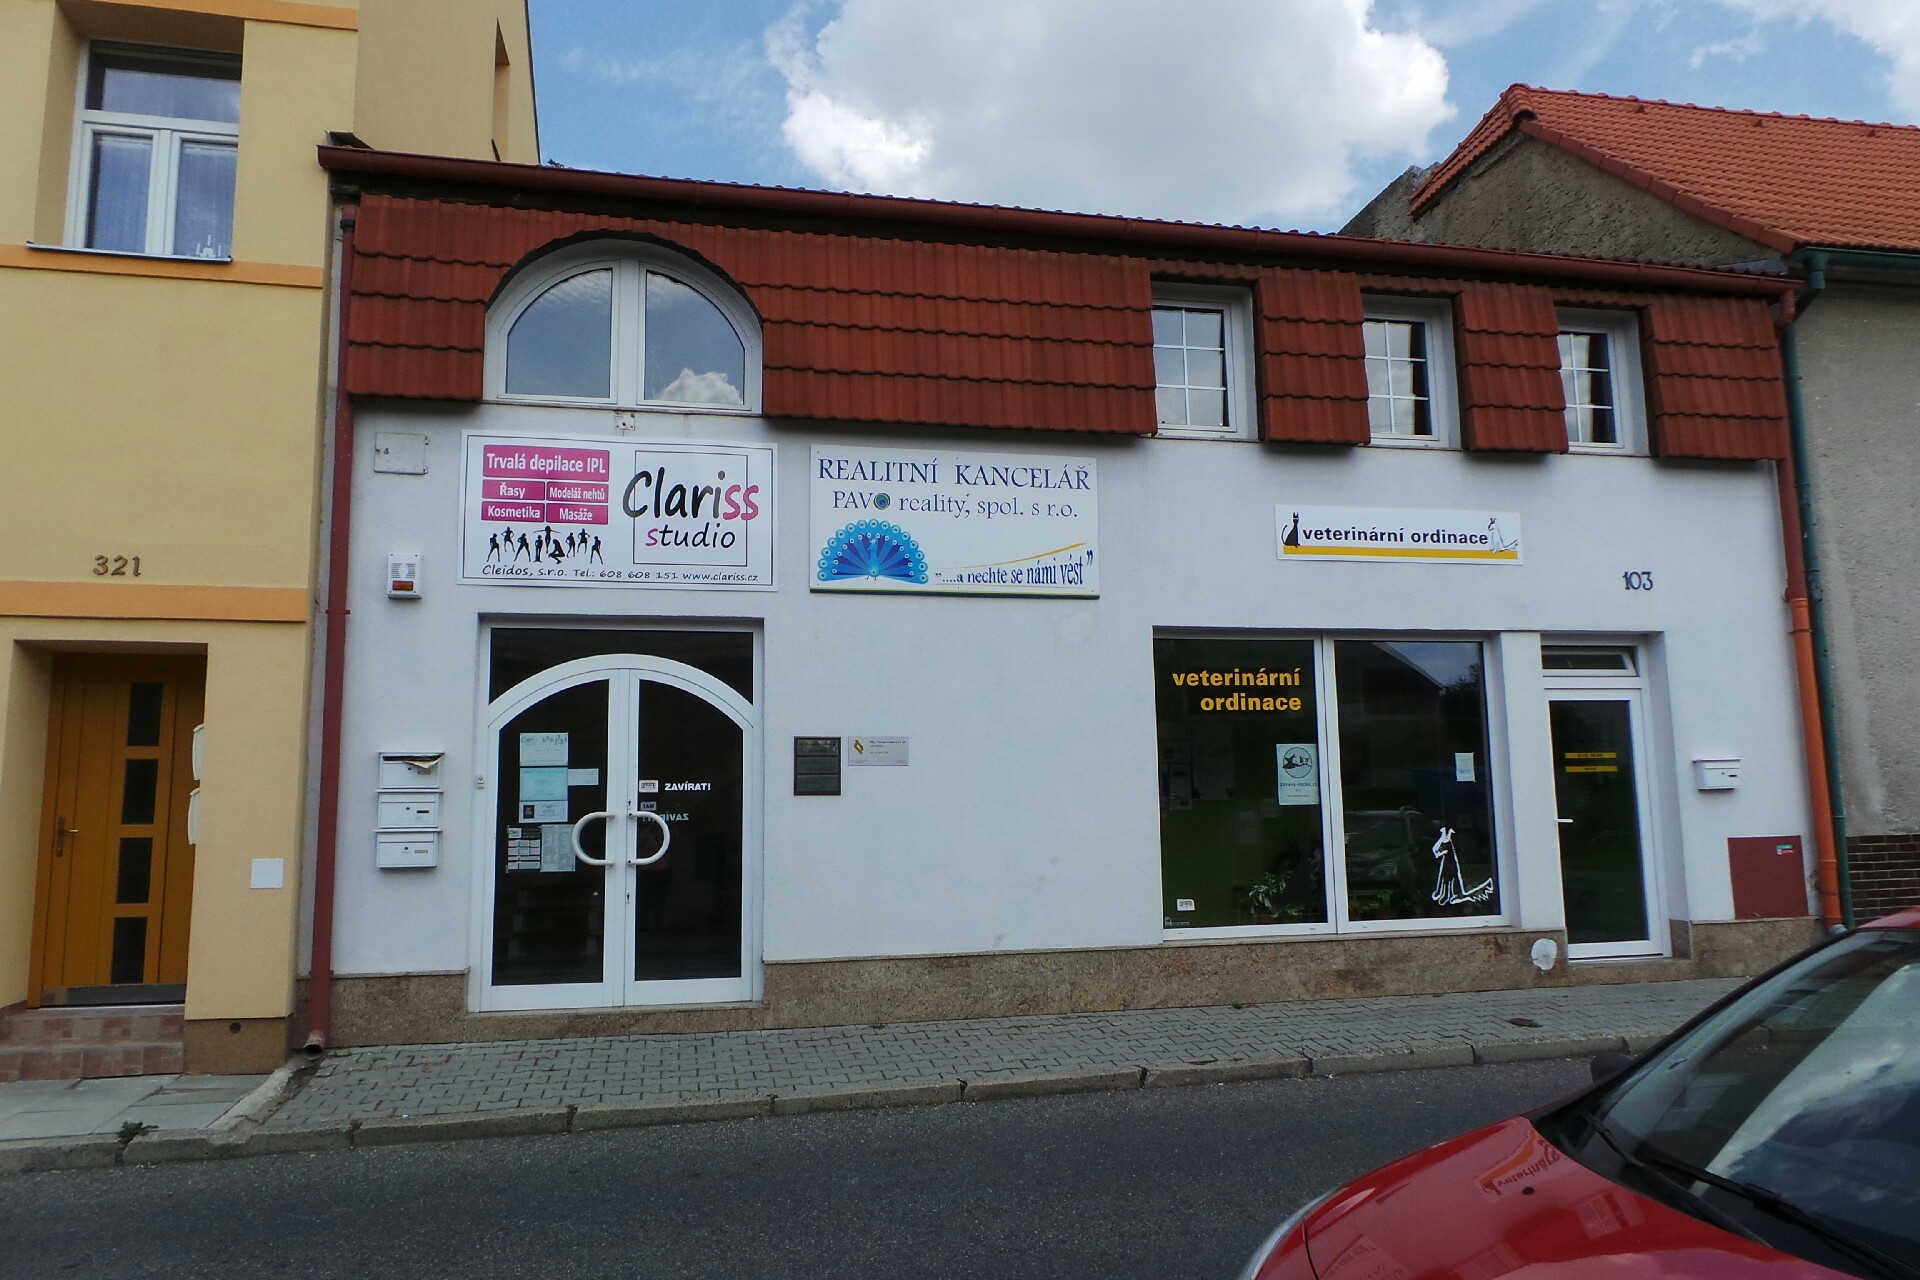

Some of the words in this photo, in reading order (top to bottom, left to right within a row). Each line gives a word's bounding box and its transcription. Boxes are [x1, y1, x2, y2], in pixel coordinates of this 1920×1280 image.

[486, 453, 526, 470] Trvalá
[529, 454, 584, 474] depilace
[587, 457, 606, 474] IPL
[818, 457, 939, 484] REALITNÍ
[954, 463, 1091, 490] KANCELÁŘ
[499, 481, 526, 499] Řasy
[549, 486, 582, 499] Modeláž
[582, 488, 605, 500] nehtů
[622, 466, 760, 521] Clariss
[488, 505, 541, 519] Kosmetika
[559, 507, 593, 521] Masáže
[832, 490, 891, 511] PAVO
[976, 497, 1024, 519] spol.
[1030, 502, 1040, 516] s
[1046, 502, 1078, 518] r.o.
[645, 522, 736, 549] studio
[1302, 525, 1405, 544] veterinární
[1410, 528, 1489, 546] ordinace
[92, 554, 142, 577] 321
[482, 564, 533, 577] Cleidos,
[538, 568, 567, 576] s.r.o.
[573, 568, 595, 578] Tel.:
[599, 570, 622, 578] 608
[627, 571, 651, 579] 608
[656, 572, 679, 580] 151
[682, 572, 759, 582] www.clariss.cz
[967, 567, 1008, 584] nechte
[1010, 569, 1024, 584] se
[1026, 559, 1057, 585] námi
[1622, 571, 1653, 591] 103
[1172, 668, 1301, 686] veterinární
[1200, 692, 1302, 711] ordinace
[664, 780, 711, 791] ZAVÍRAT!
